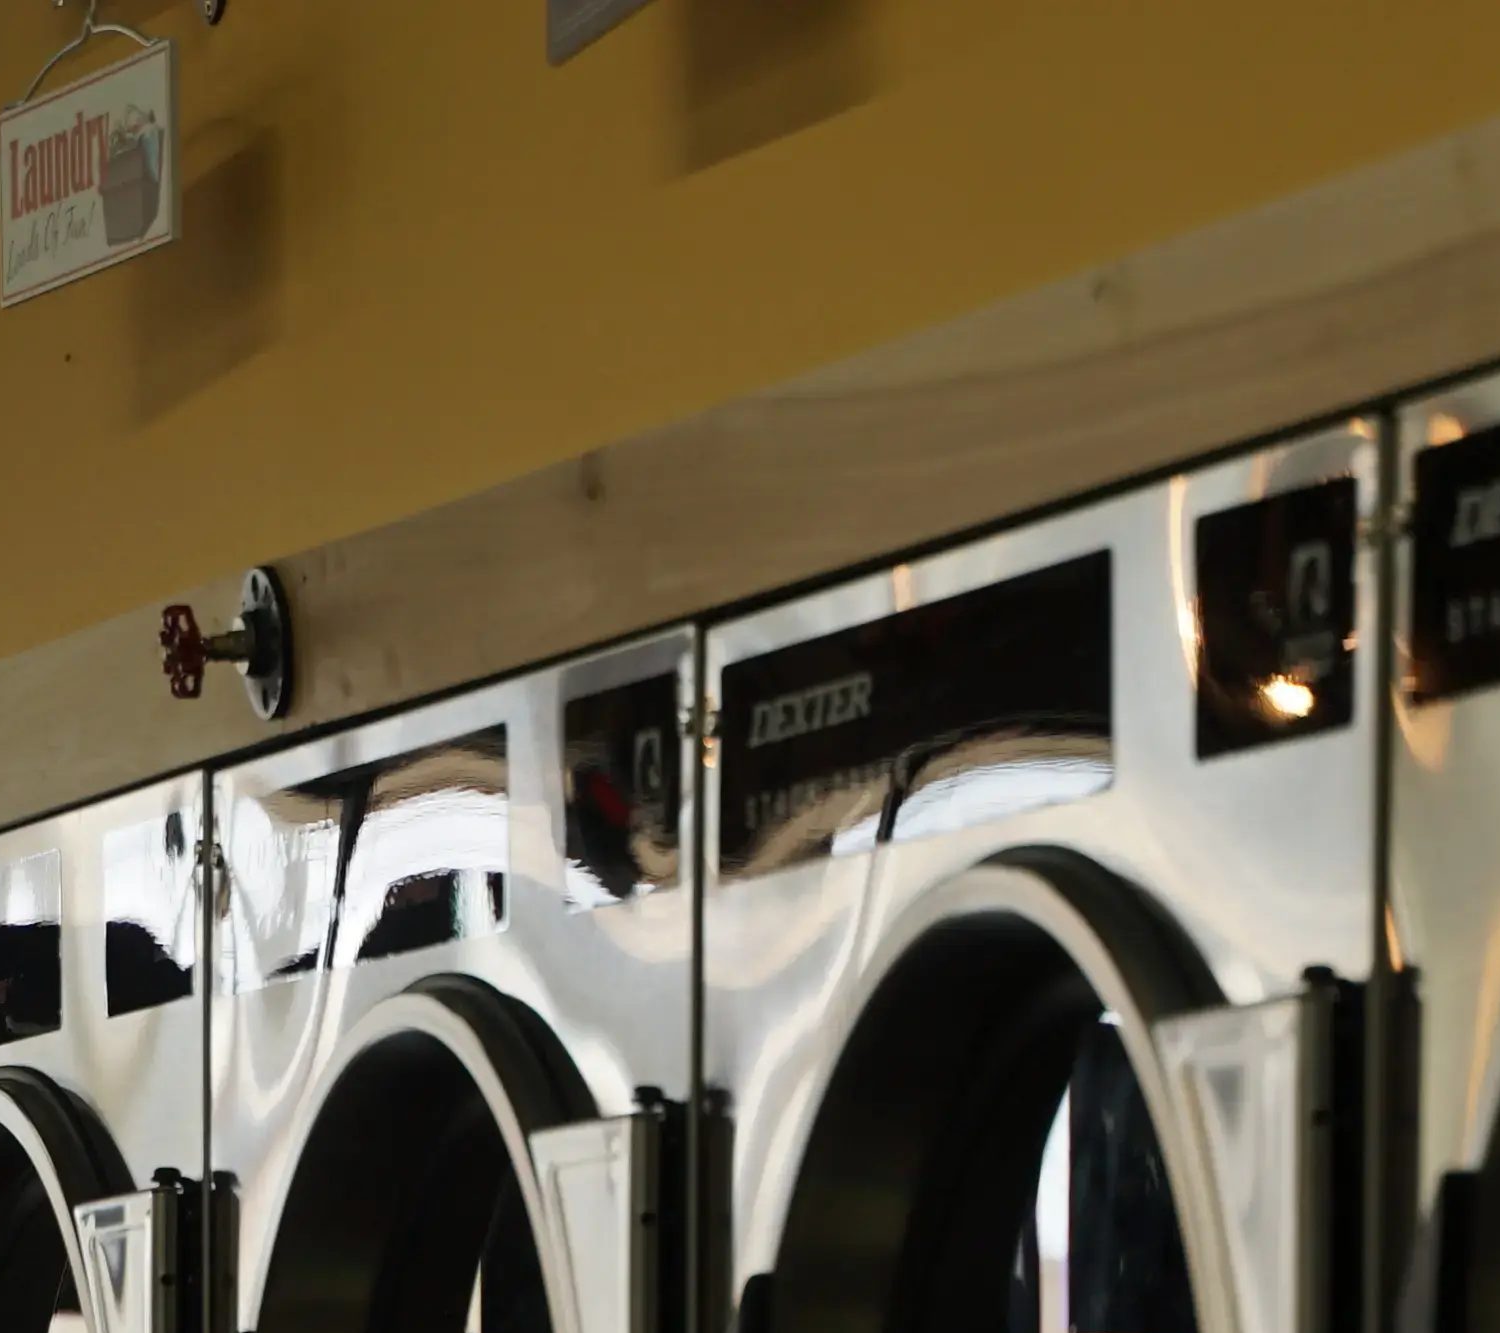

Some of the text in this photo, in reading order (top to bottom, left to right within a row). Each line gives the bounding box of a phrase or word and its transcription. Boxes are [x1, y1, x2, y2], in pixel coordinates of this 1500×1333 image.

[10, 110, 109, 219] Laundry
[7, 199, 96, 284] Loads Of Fun!
[746, 670, 873, 749] DEXTER
